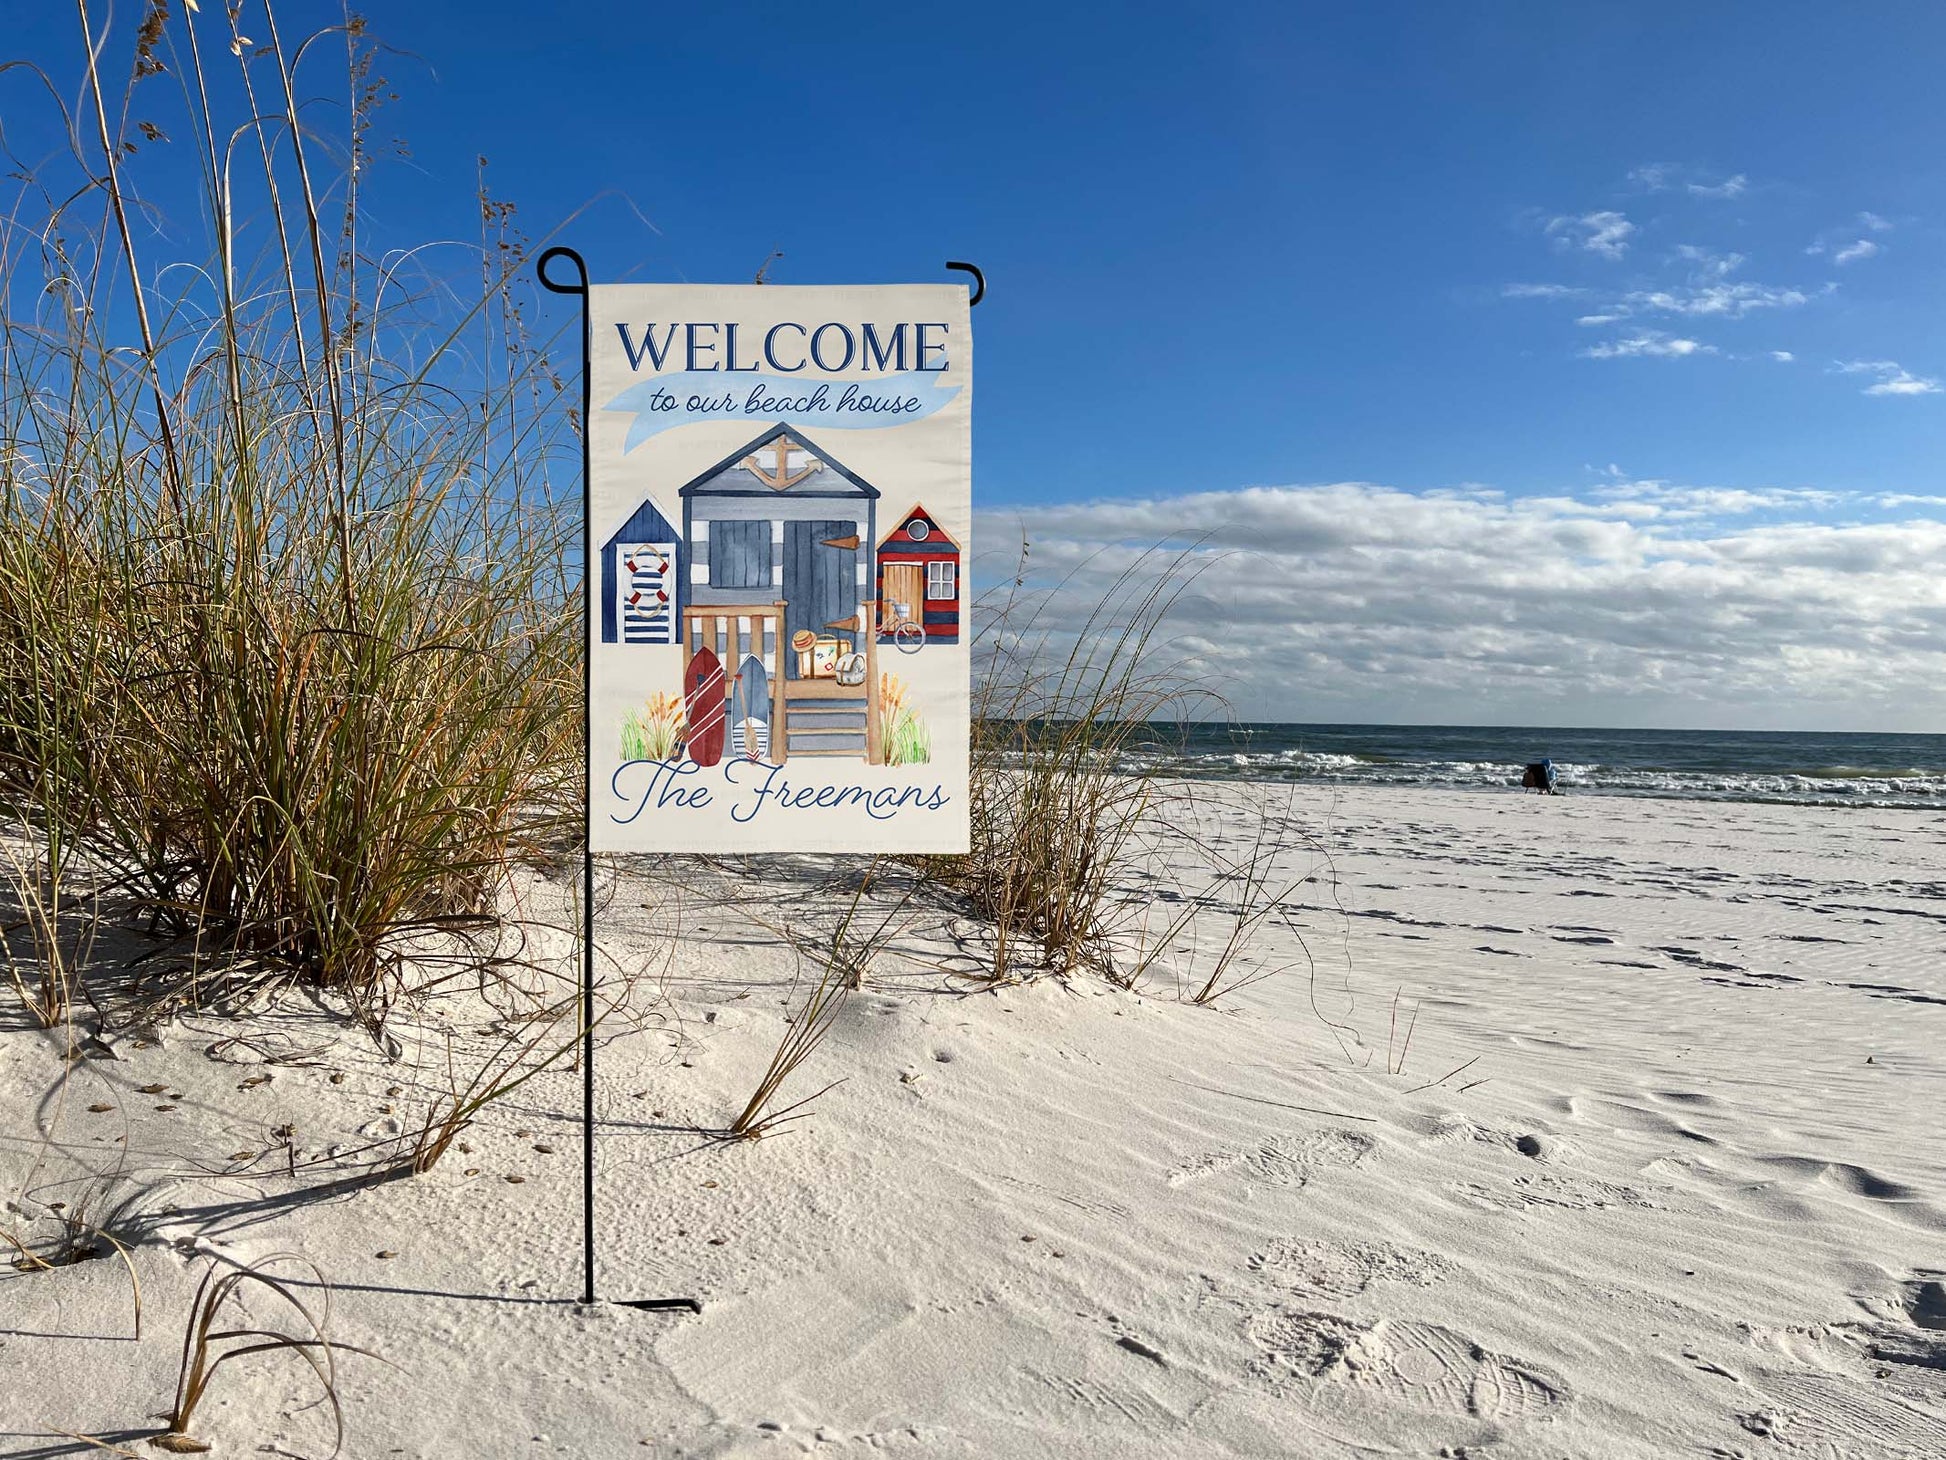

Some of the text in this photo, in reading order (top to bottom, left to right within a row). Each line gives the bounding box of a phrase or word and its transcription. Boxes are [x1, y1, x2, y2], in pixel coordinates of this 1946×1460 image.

[615, 322, 951, 373] WELCOME
[650, 383, 922, 414] to our beach house
[610, 756, 951, 824] The Freemans
